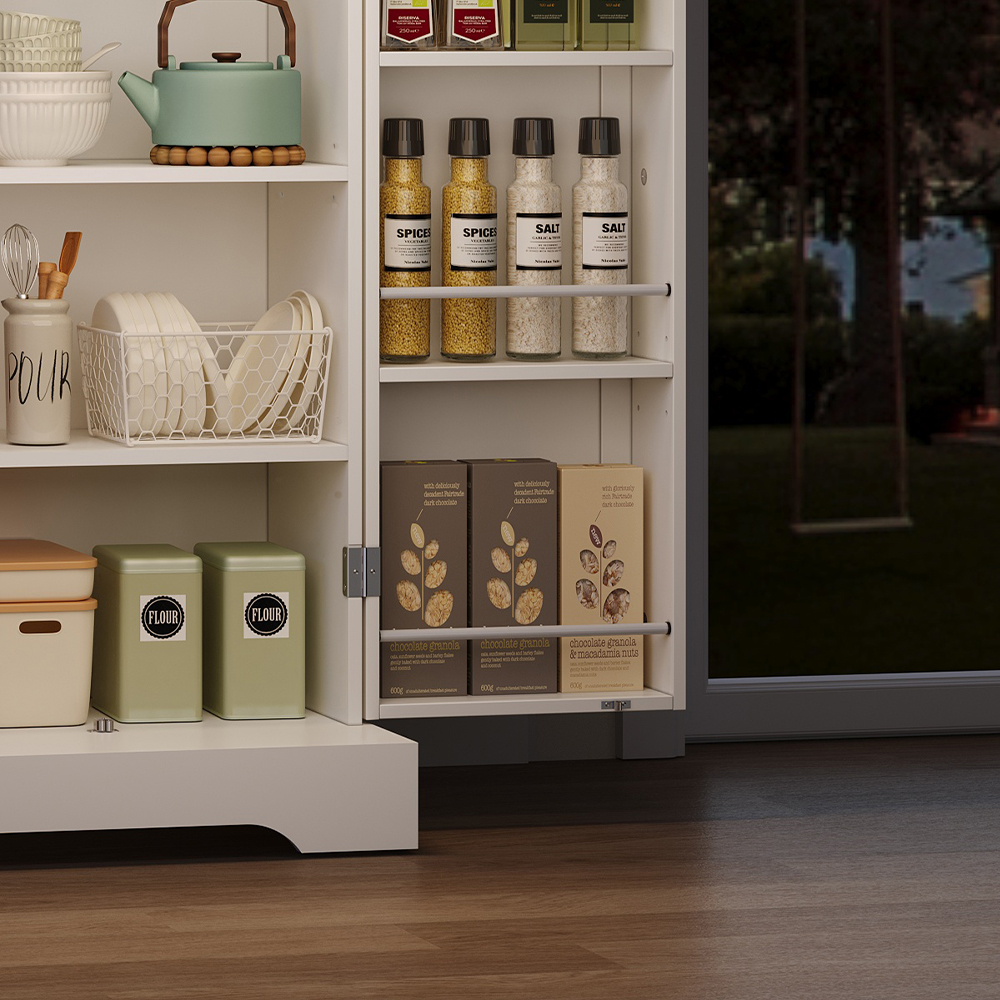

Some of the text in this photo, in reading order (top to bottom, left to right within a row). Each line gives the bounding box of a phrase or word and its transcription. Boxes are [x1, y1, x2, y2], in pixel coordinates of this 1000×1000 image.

[396, 228, 431, 238] SPICES
[463, 227, 497, 238] SPICES
[535, 223, 560, 234] SALT
[602, 223, 626, 233] SALT
[8, 349, 72, 404] POUR
[148, 610, 178, 624] FLOUR
[251, 607, 282, 622] FLOUR
[390, 639, 461, 652] chocolate granola
[480, 637, 550, 650] chocolate granola
[569, 637, 637, 649] chocolate granola
[569, 648, 639, 659] & macadamia nuts
[390, 686, 404, 695] 600g
[480, 684, 494, 692] 600g
